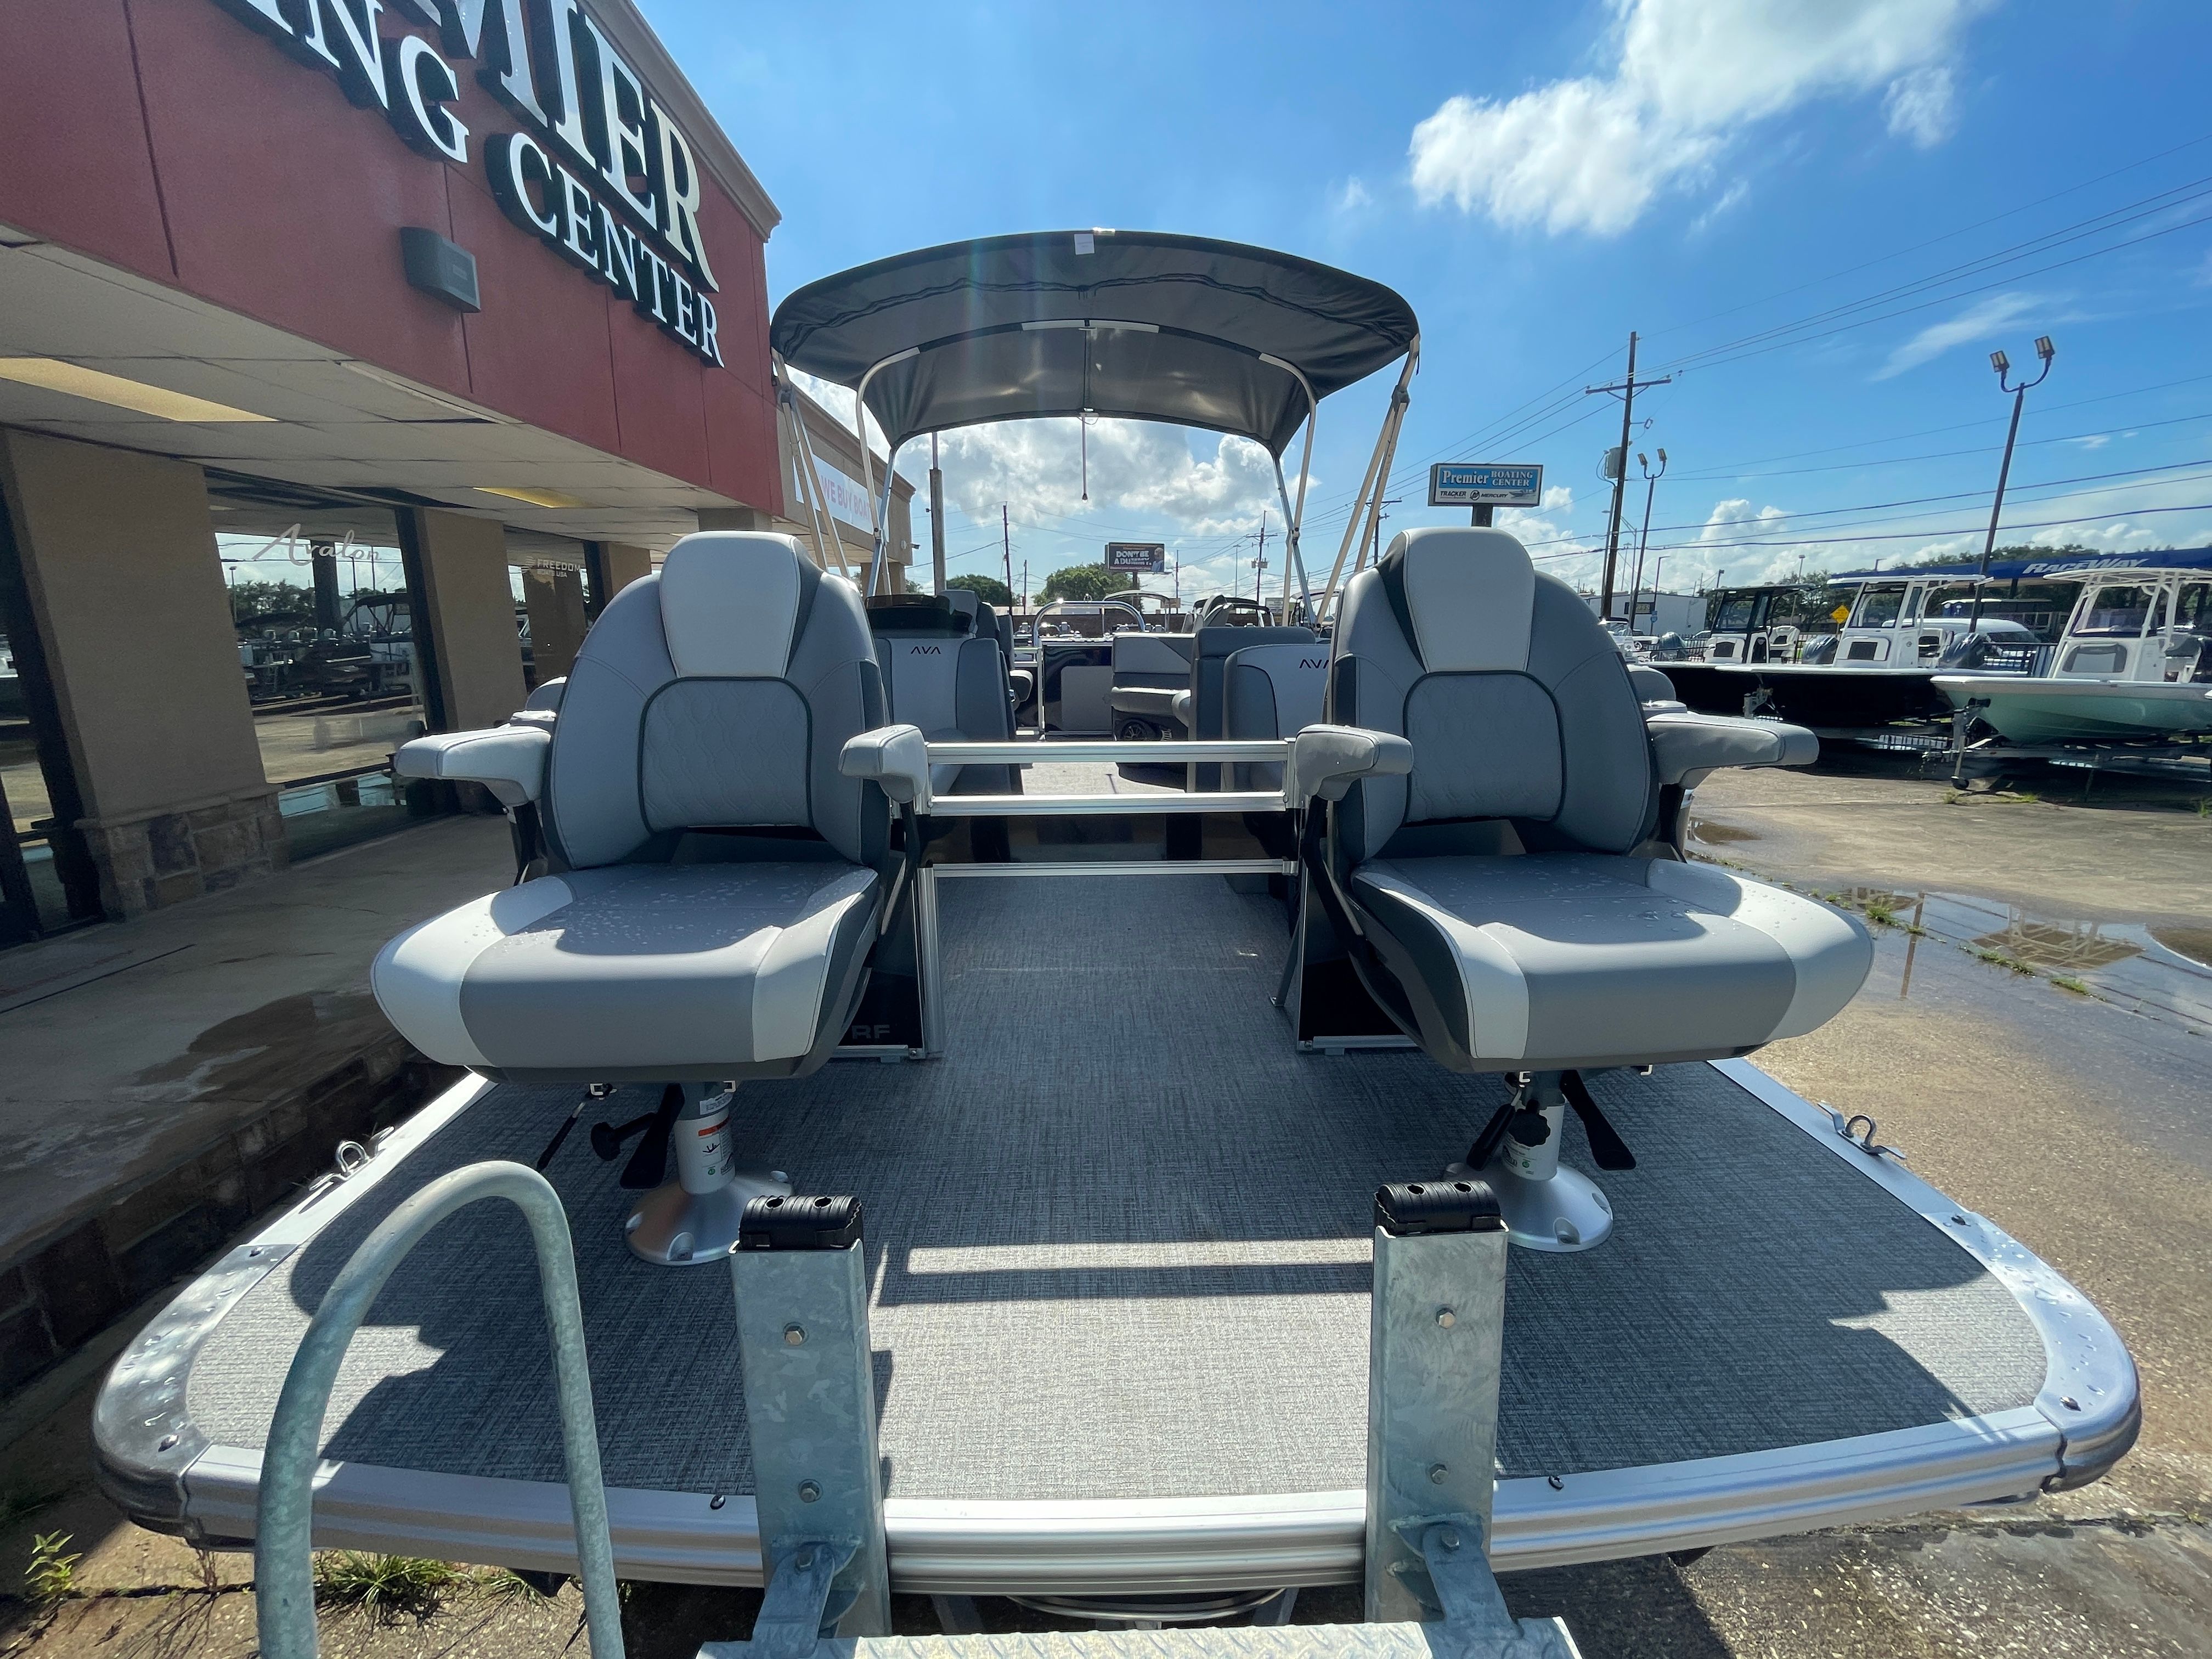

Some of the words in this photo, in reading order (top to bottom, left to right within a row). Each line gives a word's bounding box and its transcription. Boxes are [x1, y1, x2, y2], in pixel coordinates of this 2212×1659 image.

[246, 0, 469, 163] NG
[510, 132, 724, 368] CENTER
[821, 475, 836, 503] WE
[838, 484, 852, 511] BUY
[1442, 470, 1489, 484] Premier
[251, 523, 382, 566] Avalon
[537, 558, 580, 572] FREEDOM
